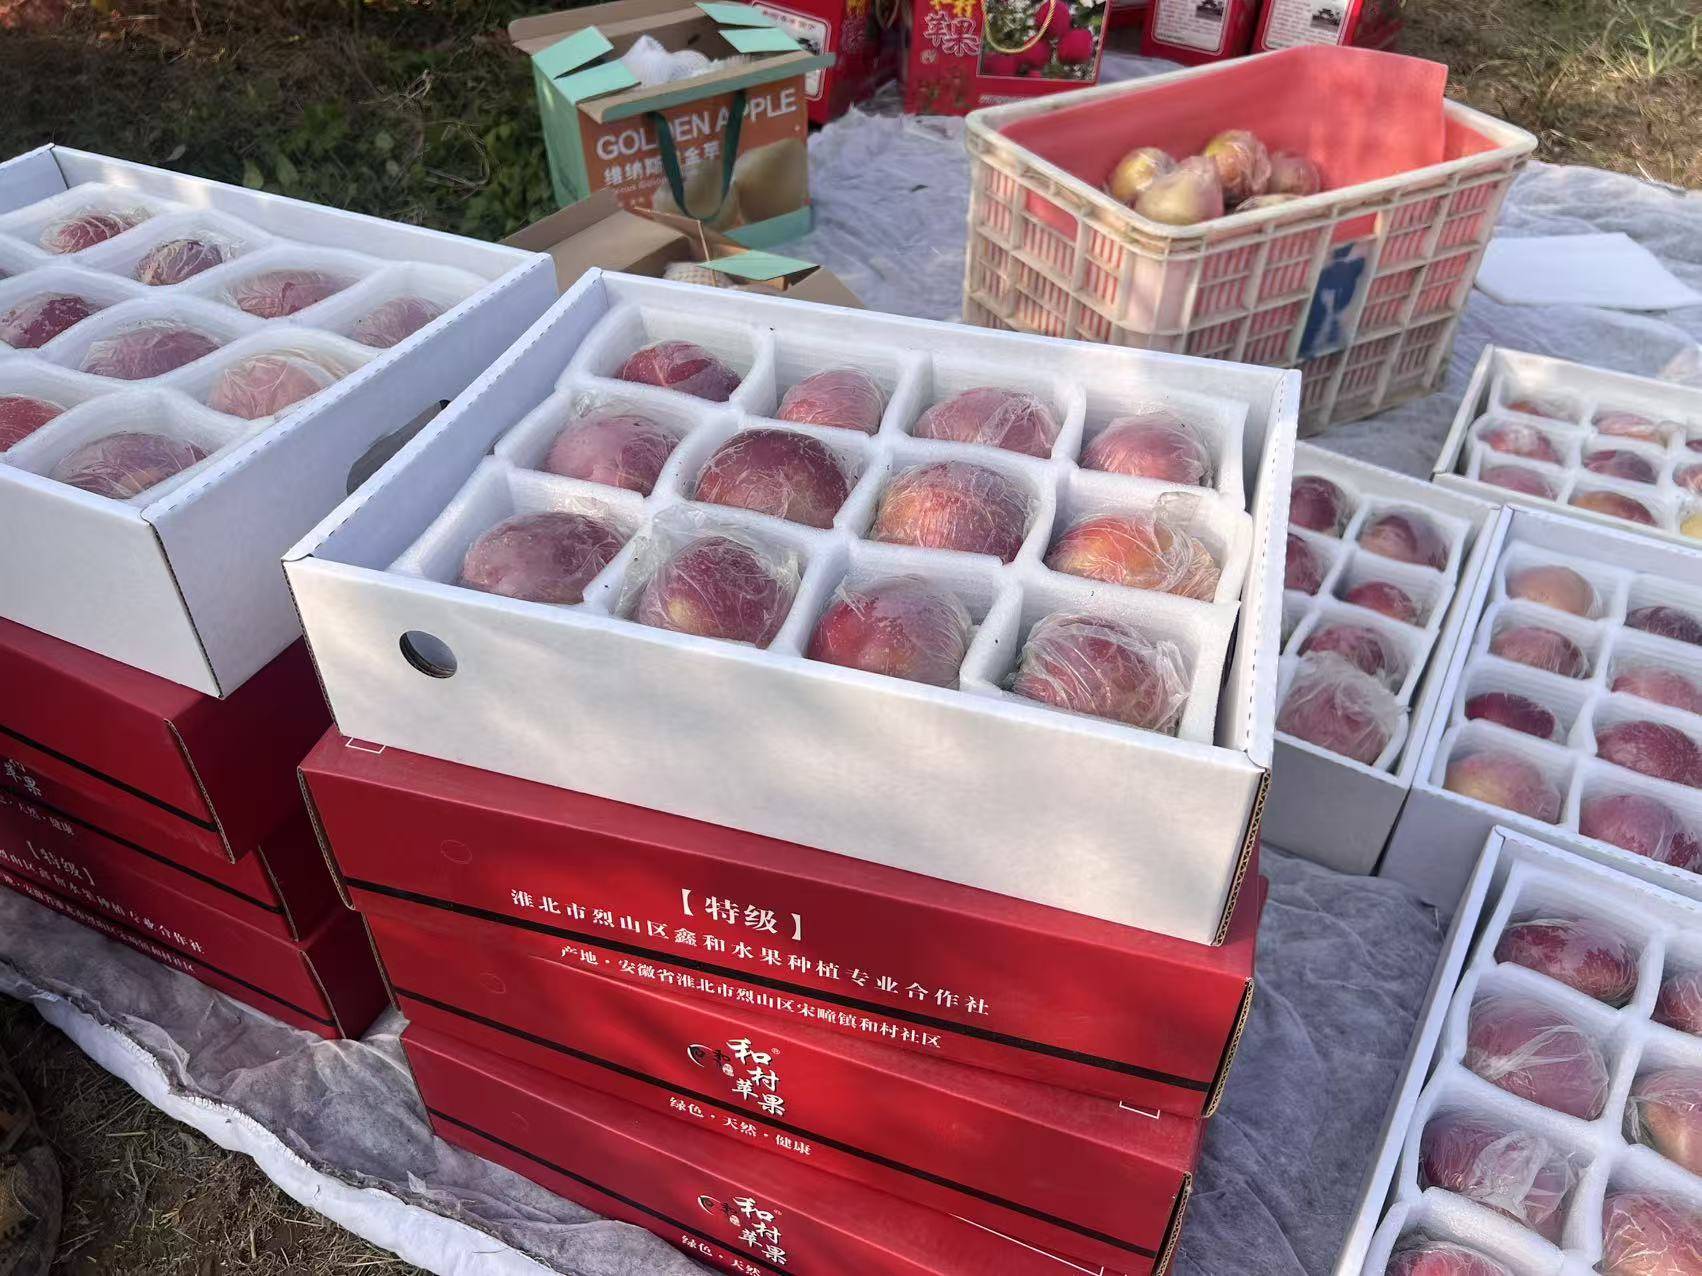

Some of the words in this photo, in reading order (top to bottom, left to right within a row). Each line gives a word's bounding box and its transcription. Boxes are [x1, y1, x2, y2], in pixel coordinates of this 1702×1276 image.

[922, 10, 982, 56] 苹果
[596, 110, 711, 160] GOLEN
[715, 87, 797, 130] APLE
[681, 888, 802, 941] 【特级】
[510, 889, 990, 1016] 淮北市烈山区鑫和水果种植专业合作社
